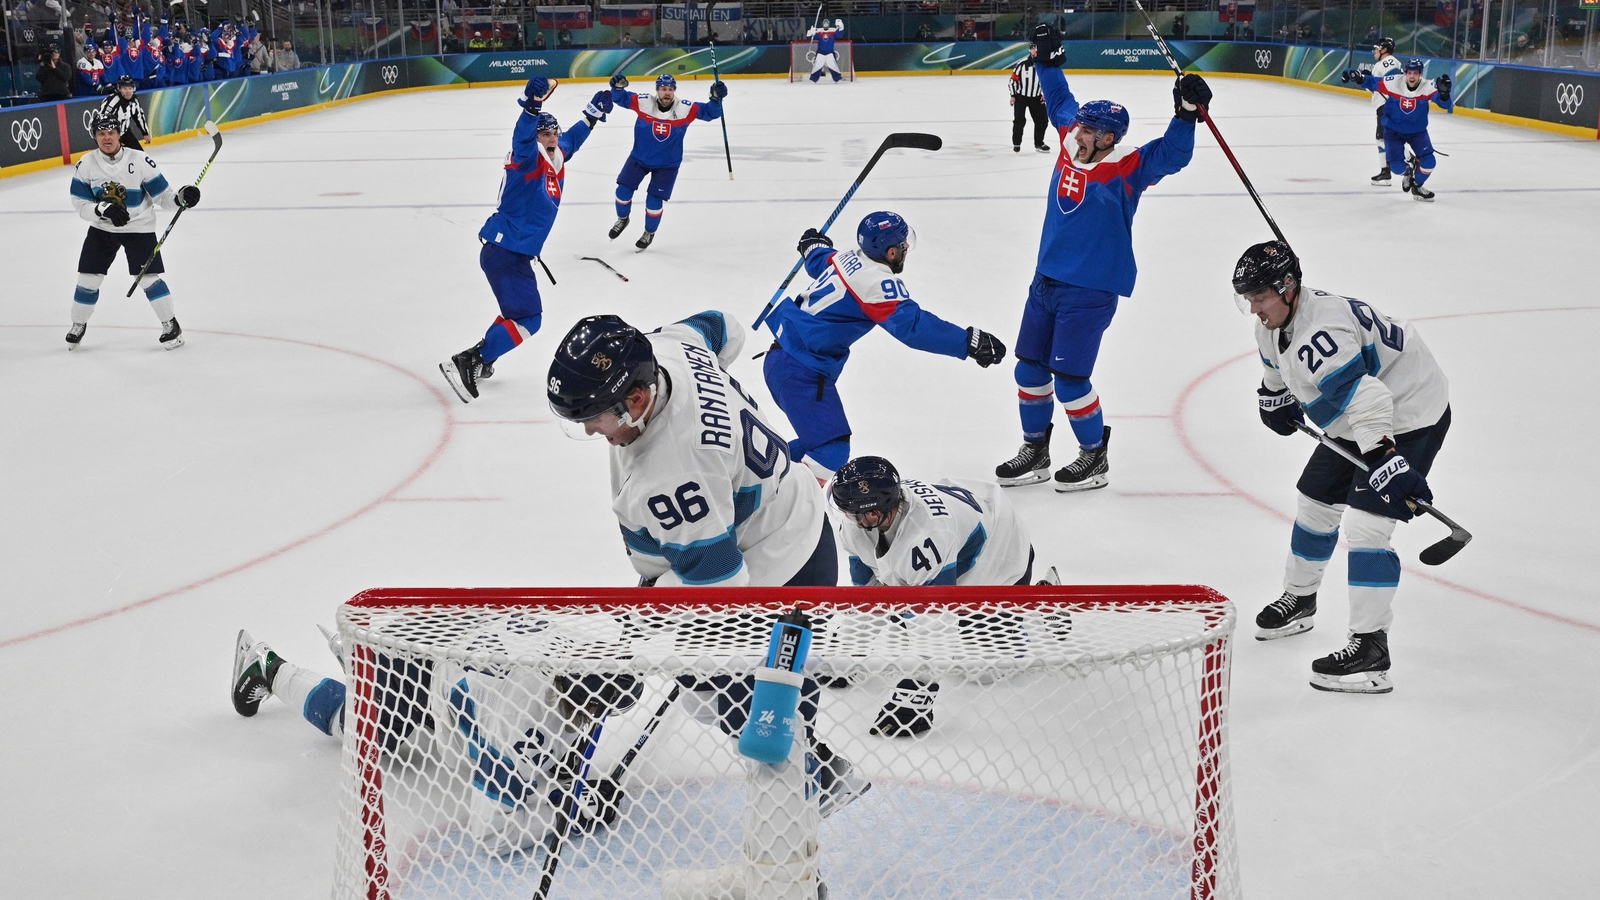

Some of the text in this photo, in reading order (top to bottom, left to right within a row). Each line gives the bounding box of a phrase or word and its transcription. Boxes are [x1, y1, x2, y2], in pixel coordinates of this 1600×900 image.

[1132, 48, 1161, 56] CORTINA
[1382, 59, 1395, 68] 62
[128, 162, 134, 174] C
[881, 279, 909, 299] 90
[1297, 330, 1339, 374] 20
[548, 376, 561, 395] 96
[611, 371, 629, 394] CCM
[681, 342, 731, 449] RANTANEN
[647, 481, 710, 531] 96
[911, 537, 942, 571] 41
